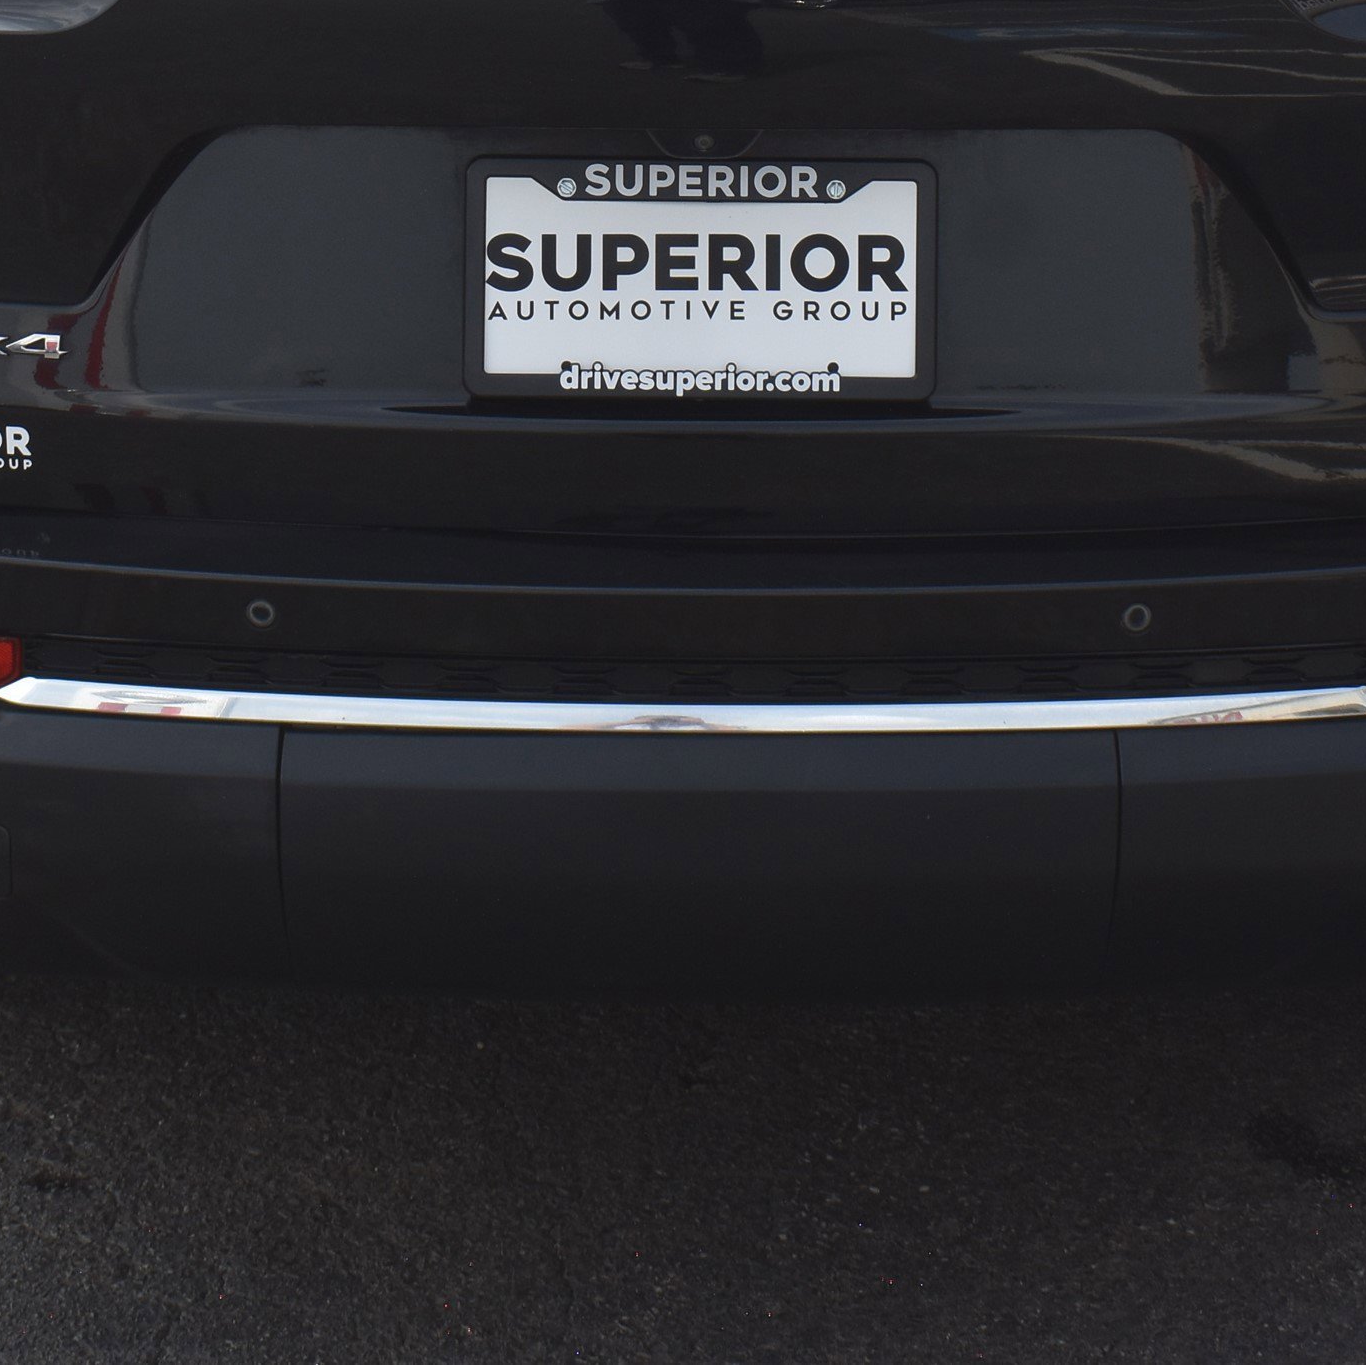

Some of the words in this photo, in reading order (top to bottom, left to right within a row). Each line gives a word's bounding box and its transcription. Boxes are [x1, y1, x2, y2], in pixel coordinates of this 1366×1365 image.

[584, 163, 819, 199] SUPERIOR
[485, 232, 910, 293] SUPERIOR
[487, 299, 747, 322] AUTOMOTIVE
[772, 300, 910, 323] GROUP
[559, 362, 842, 397] drivesuperior.com
